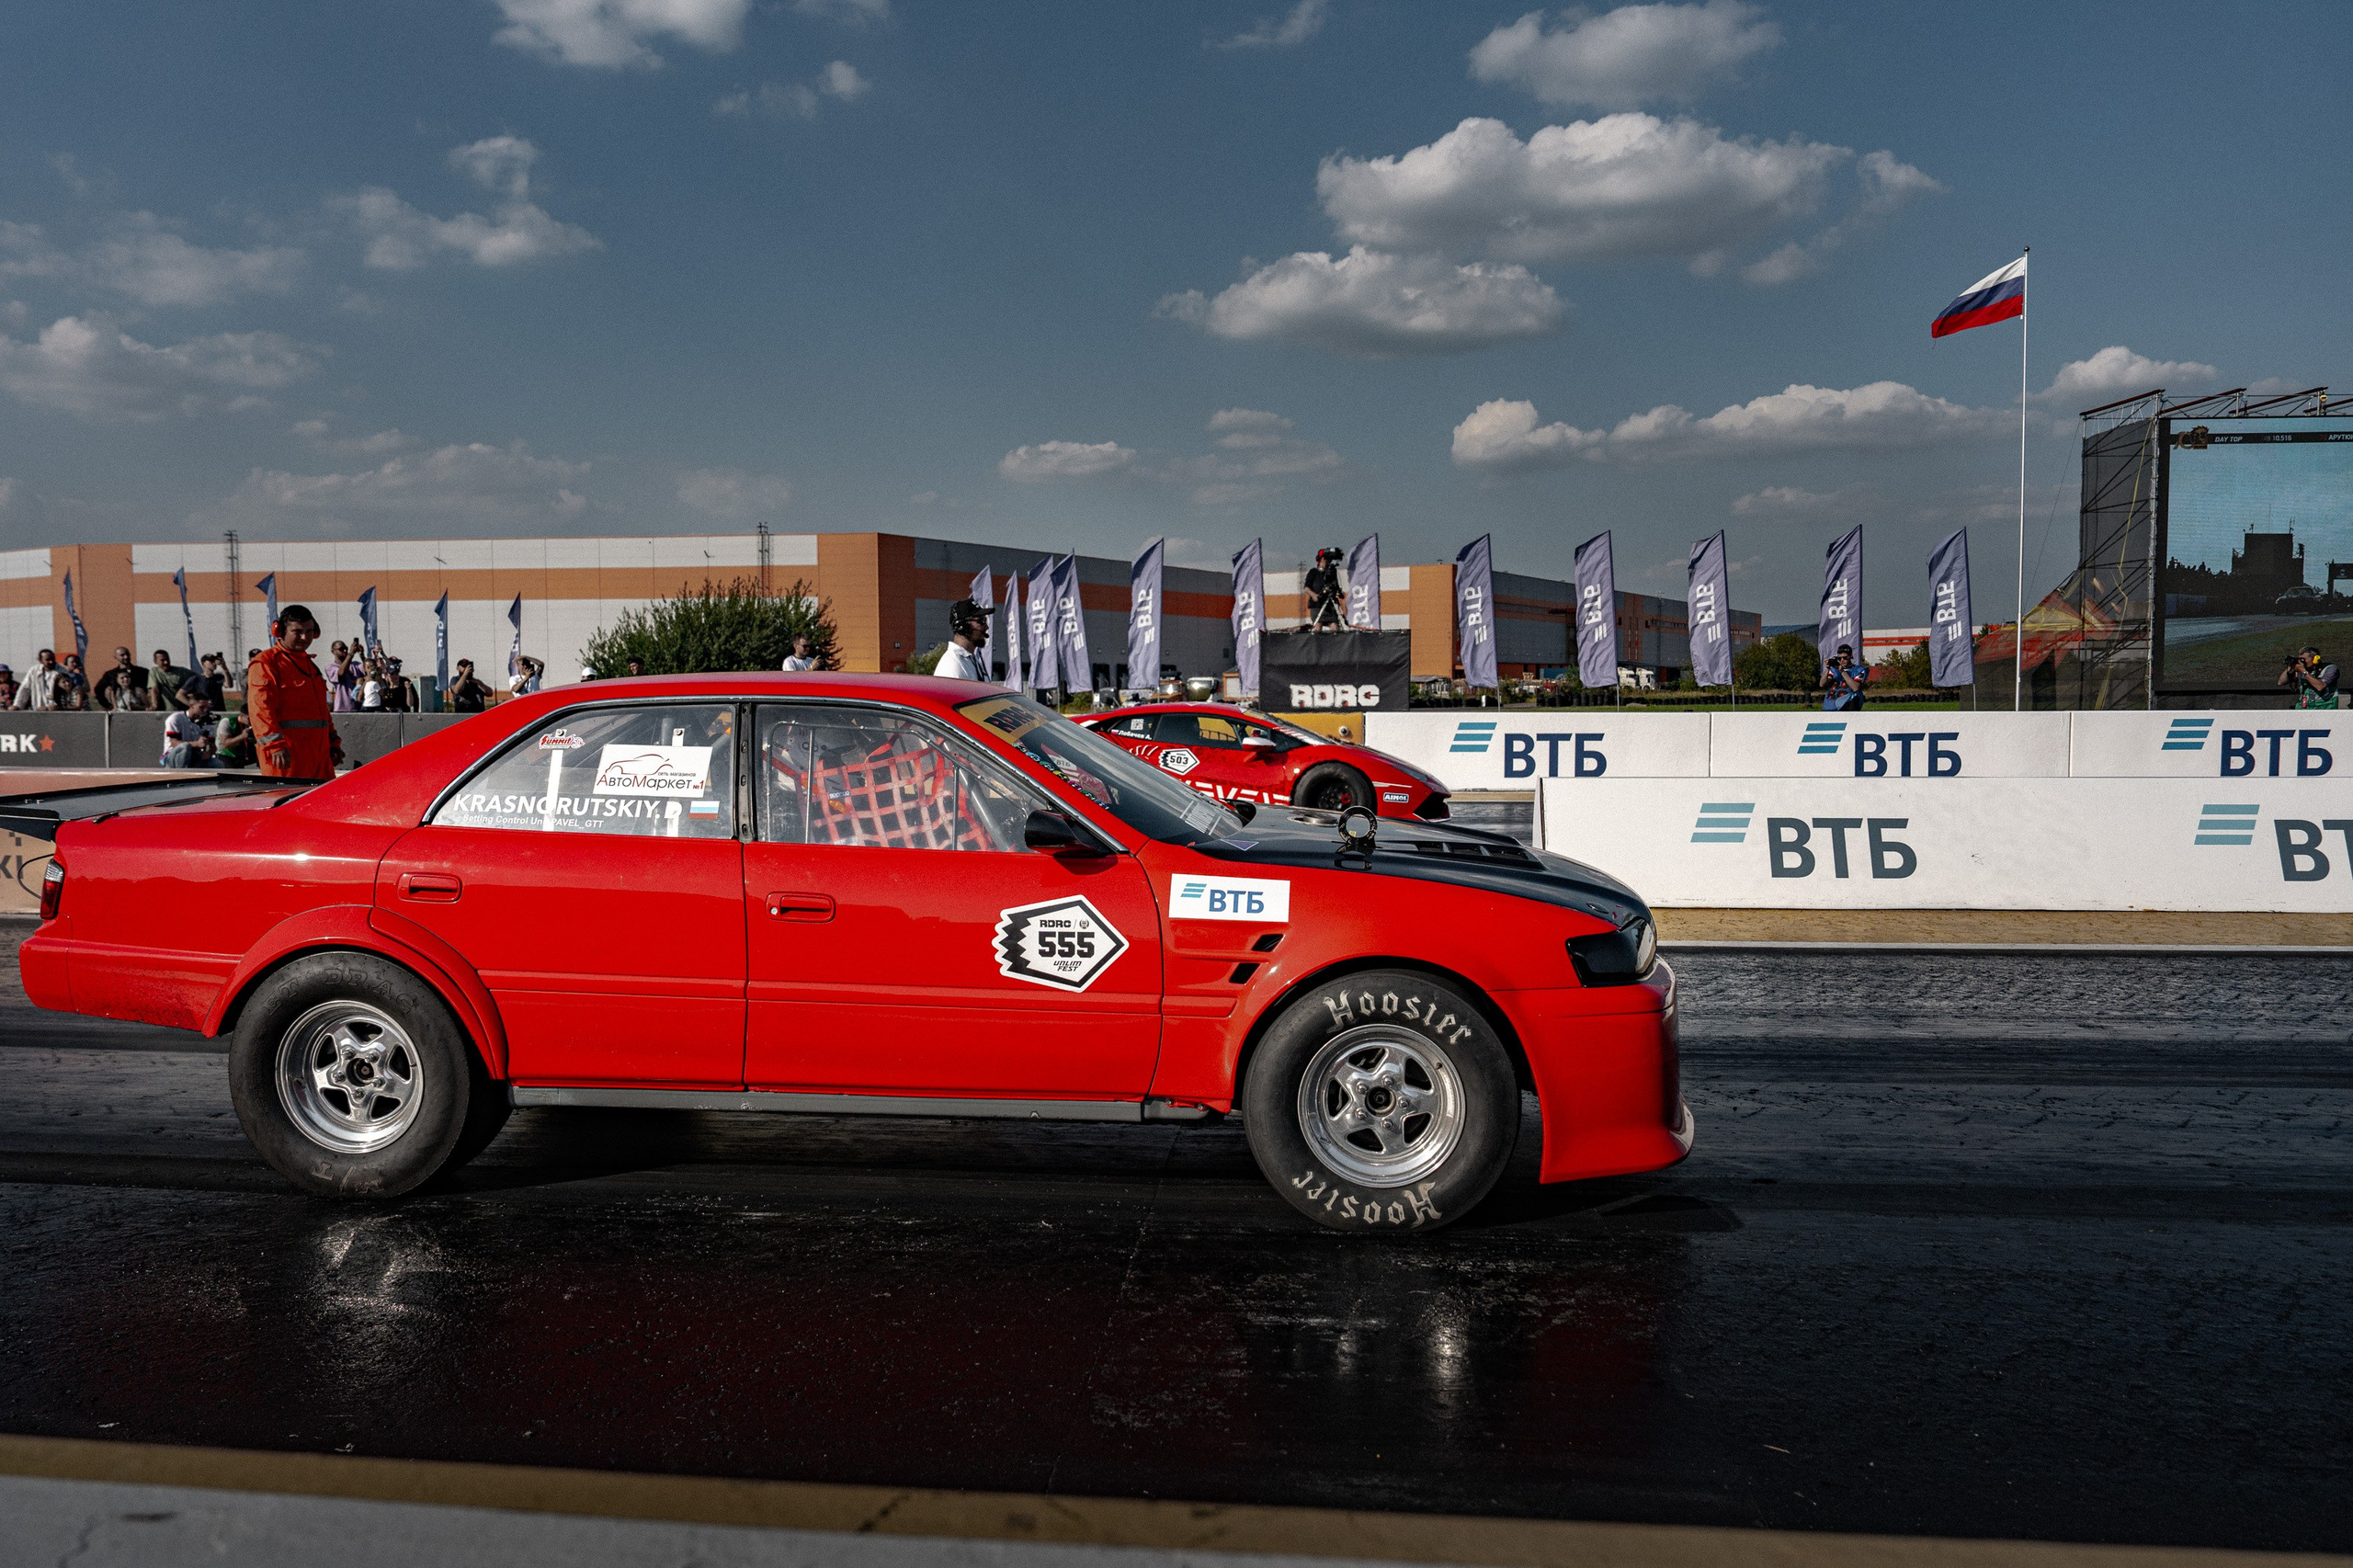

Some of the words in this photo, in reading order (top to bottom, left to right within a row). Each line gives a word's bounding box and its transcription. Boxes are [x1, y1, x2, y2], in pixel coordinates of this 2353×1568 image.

[1290, 684, 1380, 708] RDRC
[1169, 755, 1188, 765] 503
[1504, 733, 1607, 778] ВТБ
[1854, 732, 1961, 777] ВТБ
[2220, 729, 2333, 777] ВТБ
[597, 774, 692, 790] АвтоМаркет
[463, 813, 494, 824] Setting
[495, 814, 529, 825] Control
[1767, 817, 1917, 879] ВТБ
[1209, 889, 1265, 914] ВТБ
[1040, 919, 1072, 928] RDRC
[1038, 931, 1095, 958] 555
[1322, 989, 1472, 1045] Hoosier
[1291, 1170, 1443, 1229] Hoosier
